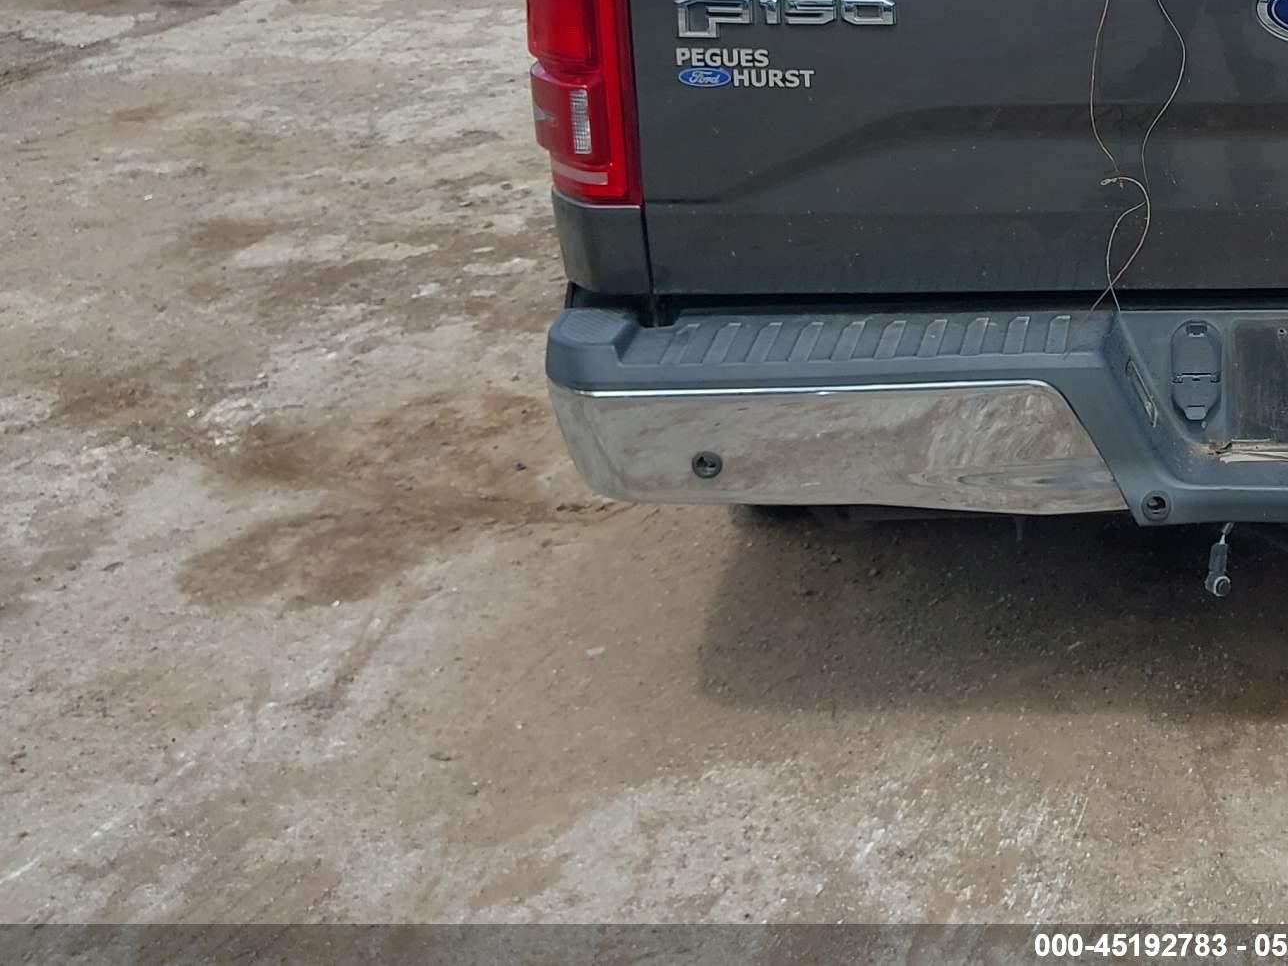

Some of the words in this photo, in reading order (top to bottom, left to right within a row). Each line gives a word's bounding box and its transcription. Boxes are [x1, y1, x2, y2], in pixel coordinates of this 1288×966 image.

[675, 47, 769, 68] PEGUES
[687, 70, 722, 85] Ford
[733, 68, 816, 88] HURST
